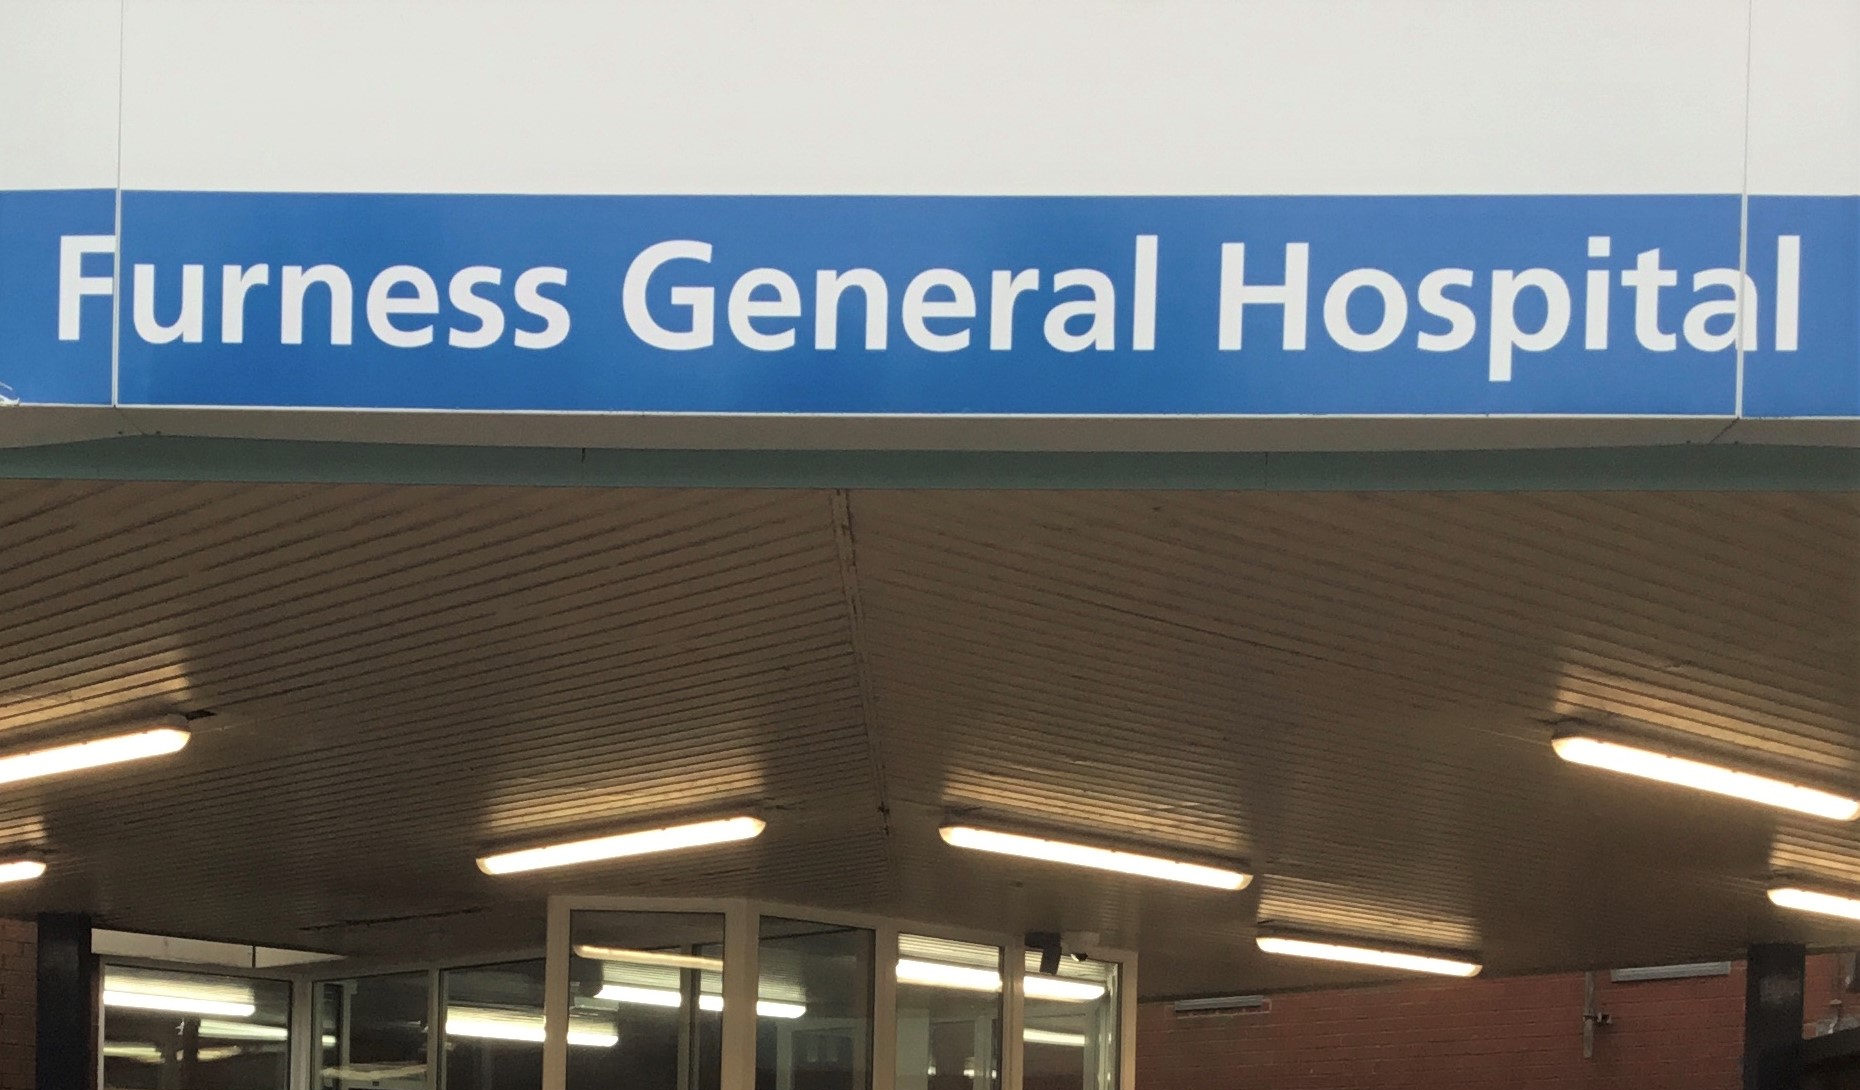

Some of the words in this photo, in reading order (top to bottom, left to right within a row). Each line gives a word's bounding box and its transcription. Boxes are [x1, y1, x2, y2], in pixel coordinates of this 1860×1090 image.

[57, 234, 572, 349] Furness
[622, 234, 1158, 353] General
[1218, 234, 1801, 383] Hospital
